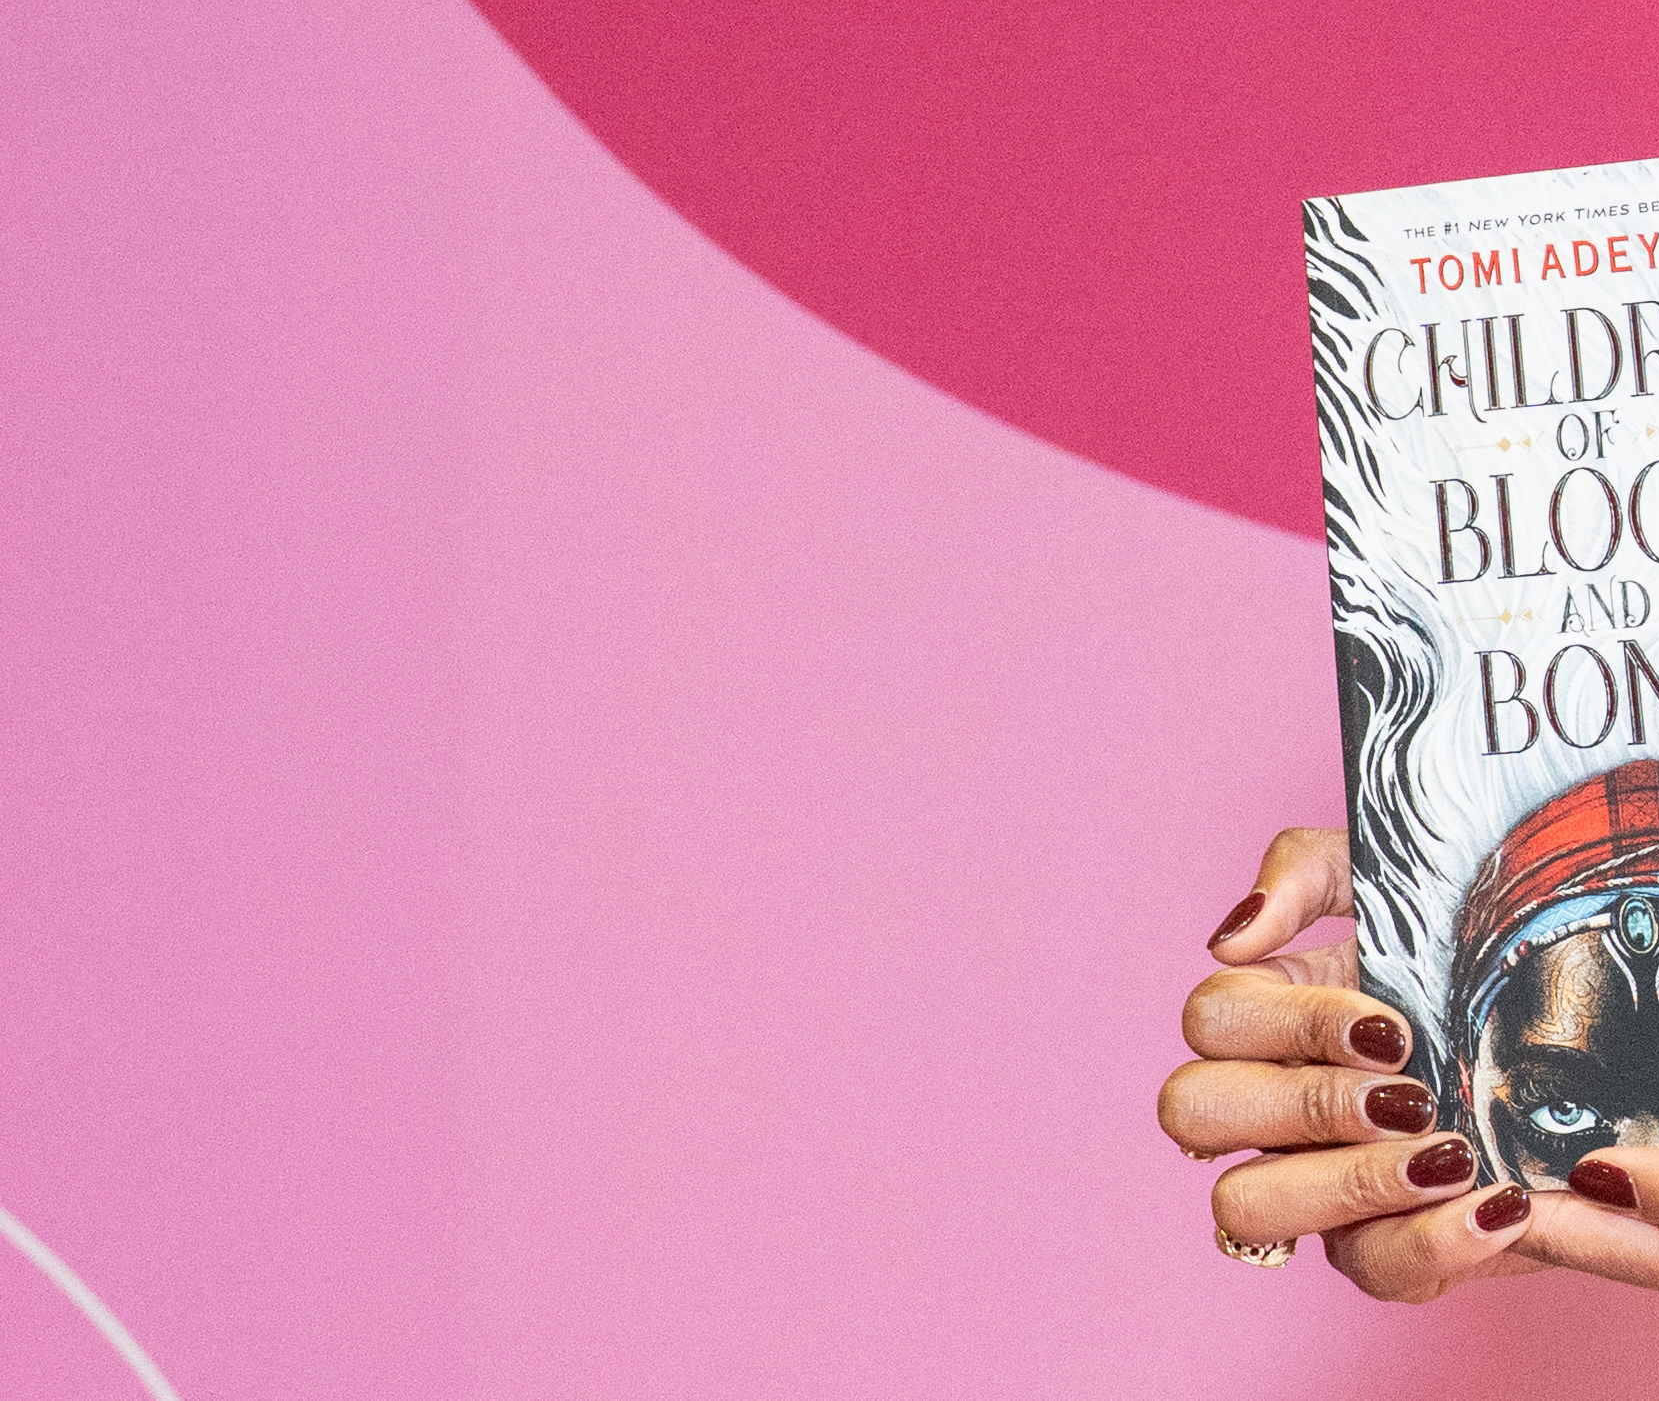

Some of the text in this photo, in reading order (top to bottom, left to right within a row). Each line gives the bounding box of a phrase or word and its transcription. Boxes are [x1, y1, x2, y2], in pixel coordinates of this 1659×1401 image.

[1404, 225, 1436, 239] THE
[1444, 221, 1461, 235] #1
[1469, 218, 1509, 233] NEW
[1518, 211, 1566, 227] YORK
[1574, 204, 1630, 220] TIMES
[1410, 248, 1522, 294] TOMI
[1556, 408, 1620, 461] OF
[1558, 575, 1651, 637] AND
